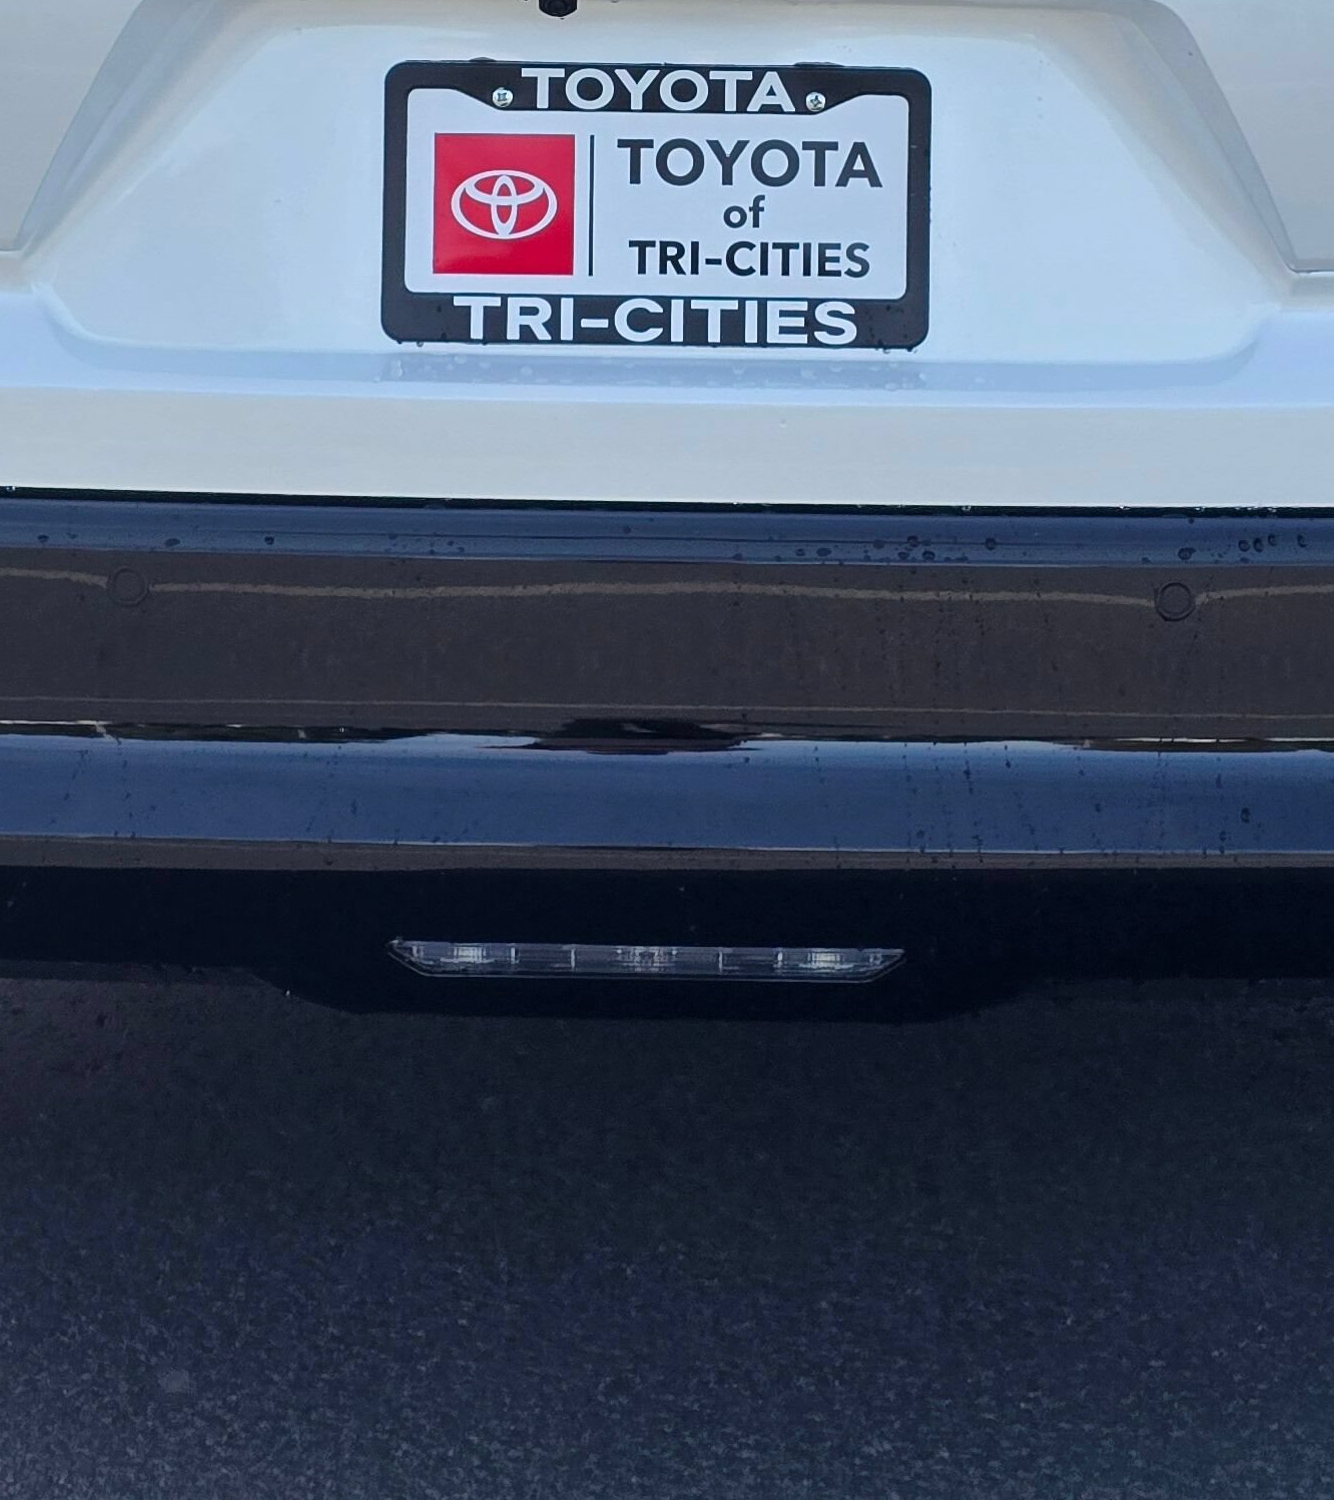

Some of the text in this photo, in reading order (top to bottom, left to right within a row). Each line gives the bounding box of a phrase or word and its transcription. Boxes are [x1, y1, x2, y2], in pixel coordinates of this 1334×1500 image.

[520, 68, 796, 112] TOYOTA
[617, 139, 883, 188] TOYOTA
[723, 195, 765, 229] of
[628, 240, 870, 278] TRI-CITIES
[453, 295, 858, 345] TRI-CITIES
